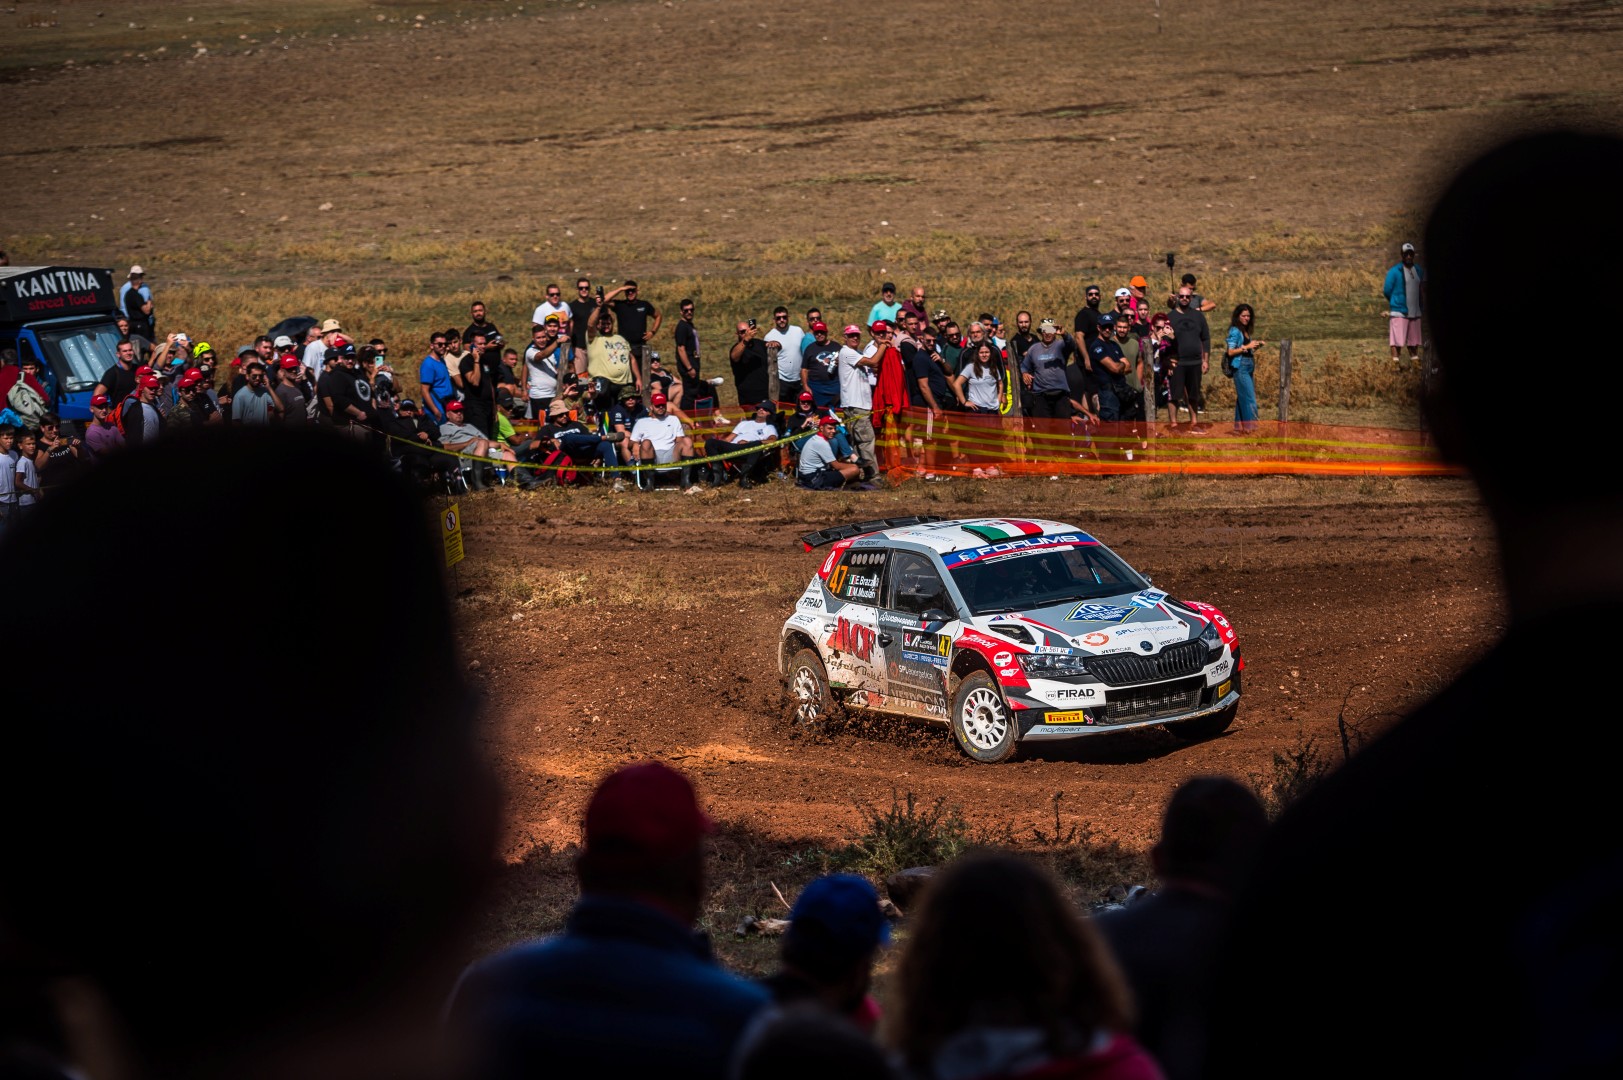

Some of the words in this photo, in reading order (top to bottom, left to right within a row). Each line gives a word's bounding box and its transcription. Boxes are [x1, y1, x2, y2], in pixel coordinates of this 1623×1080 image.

[14, 271, 101, 298] KANTINA
[28, 296, 65, 311] street
[67, 291, 97, 306] food
[829, 565, 849, 594] 47
[803, 597, 823, 609] FIRAD
[939, 635, 952, 657] 47
[1057, 688, 1096, 698] FIRAD
[1048, 712, 1080, 722] PIRELLI
